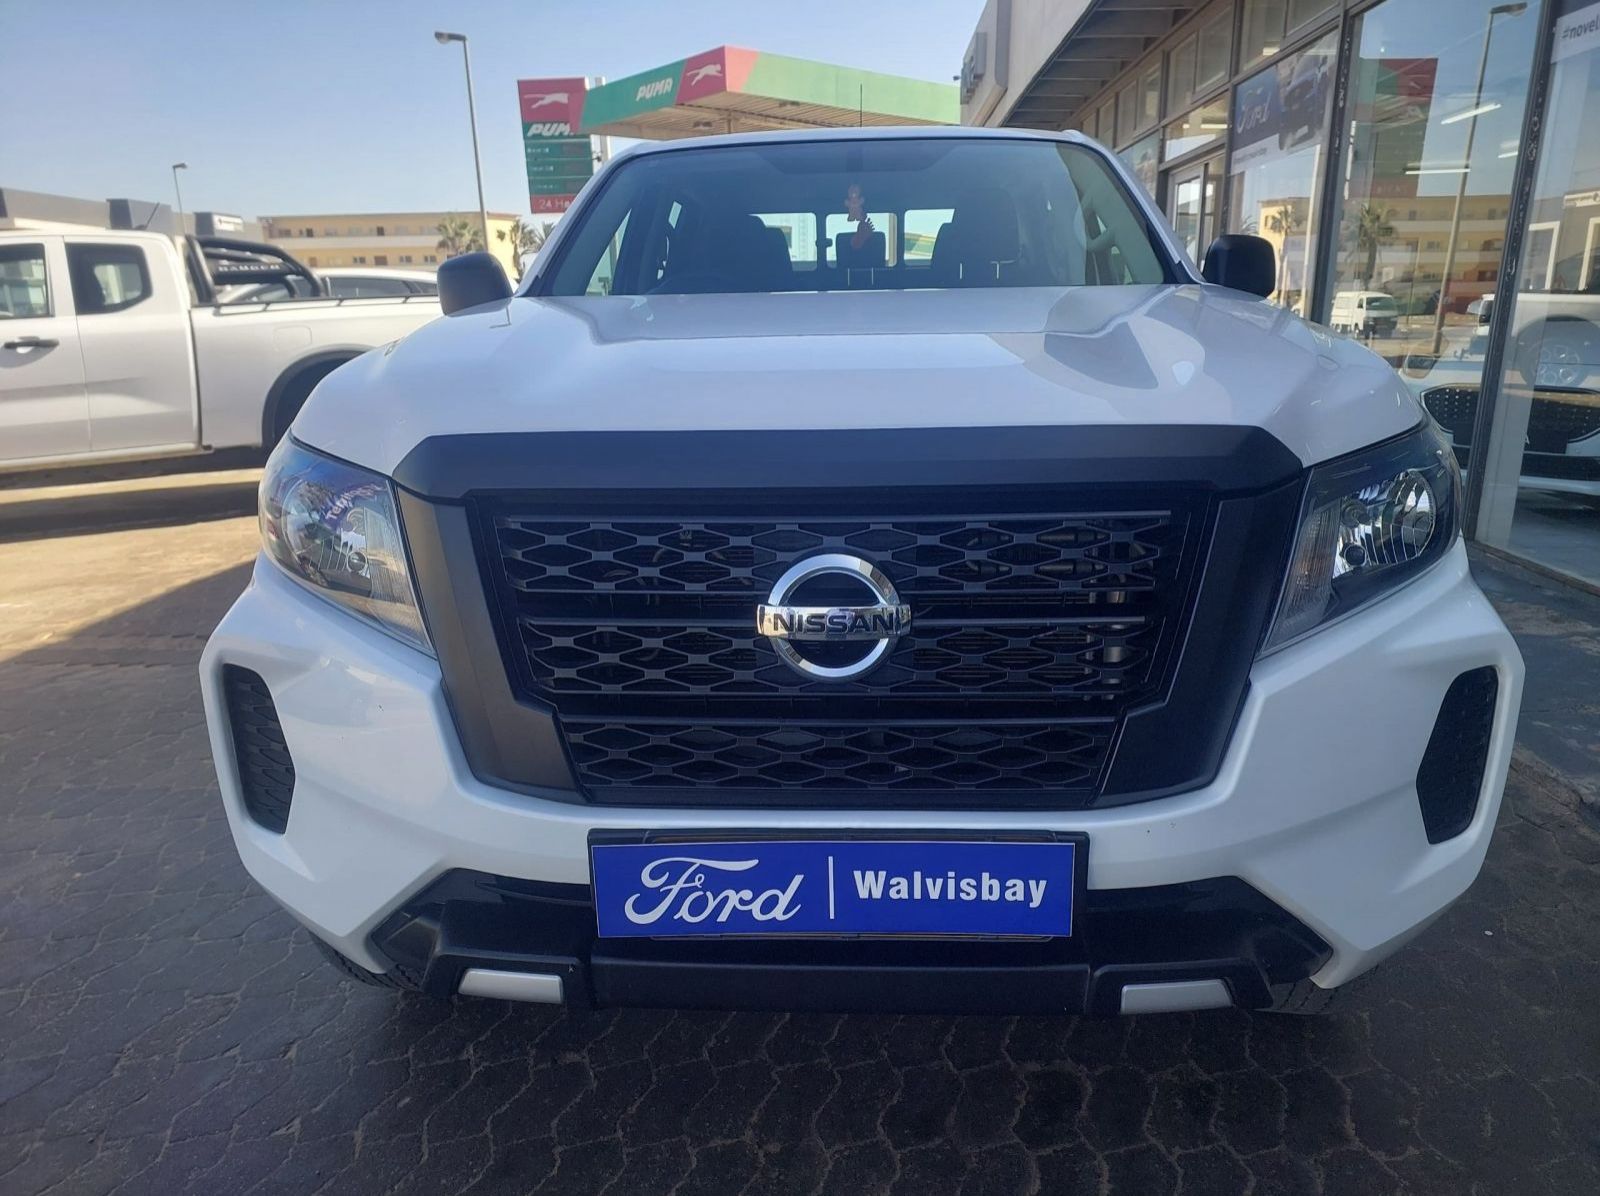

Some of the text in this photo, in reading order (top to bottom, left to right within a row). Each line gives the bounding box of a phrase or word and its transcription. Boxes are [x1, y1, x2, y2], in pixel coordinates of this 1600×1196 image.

[635, 77, 673, 102] PUMA
[527, 122, 574, 137] PUM
[773, 613, 894, 632] NISSAN
[624, 856, 1047, 925] Ford Walvisbay
